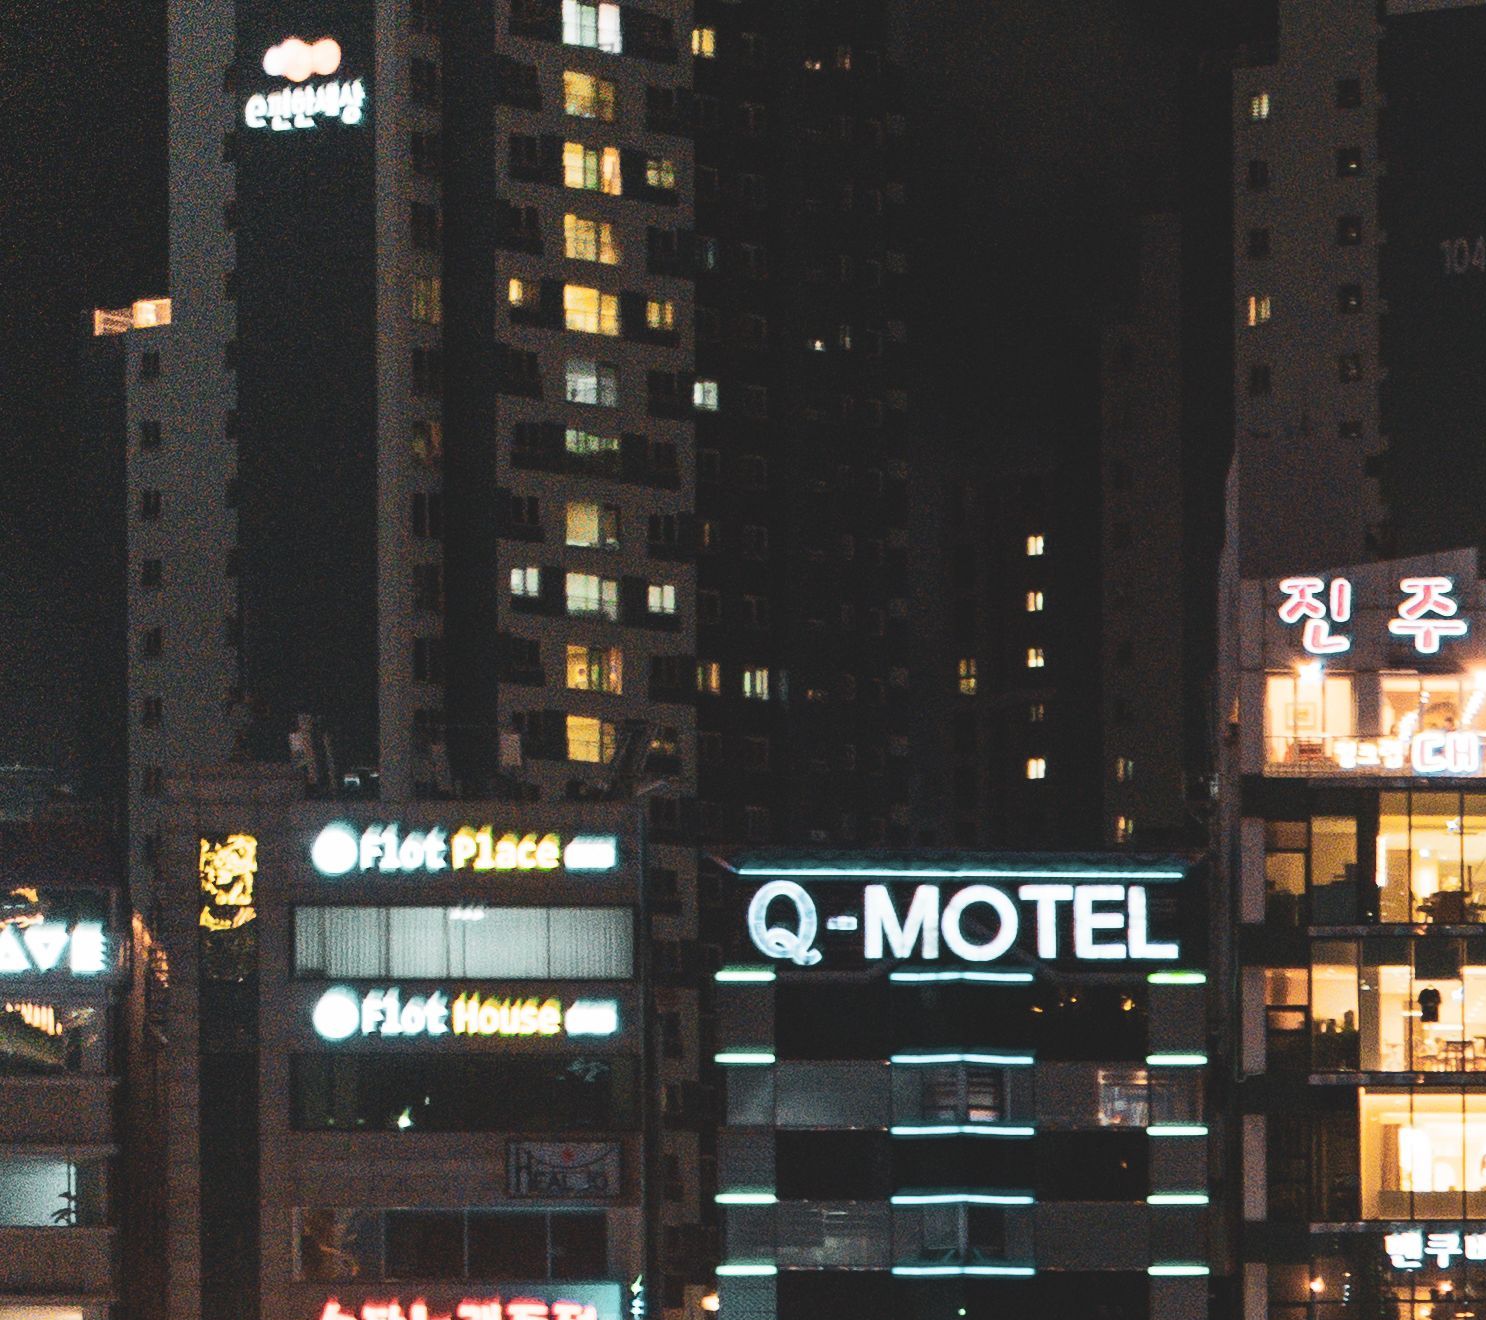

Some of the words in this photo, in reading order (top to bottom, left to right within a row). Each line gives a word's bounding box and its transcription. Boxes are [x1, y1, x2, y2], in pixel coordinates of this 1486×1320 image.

[451, 823, 563, 873] Place
[747, 880, 1180, 966] Q-MOTEL
[451, 990, 563, 1036] House
